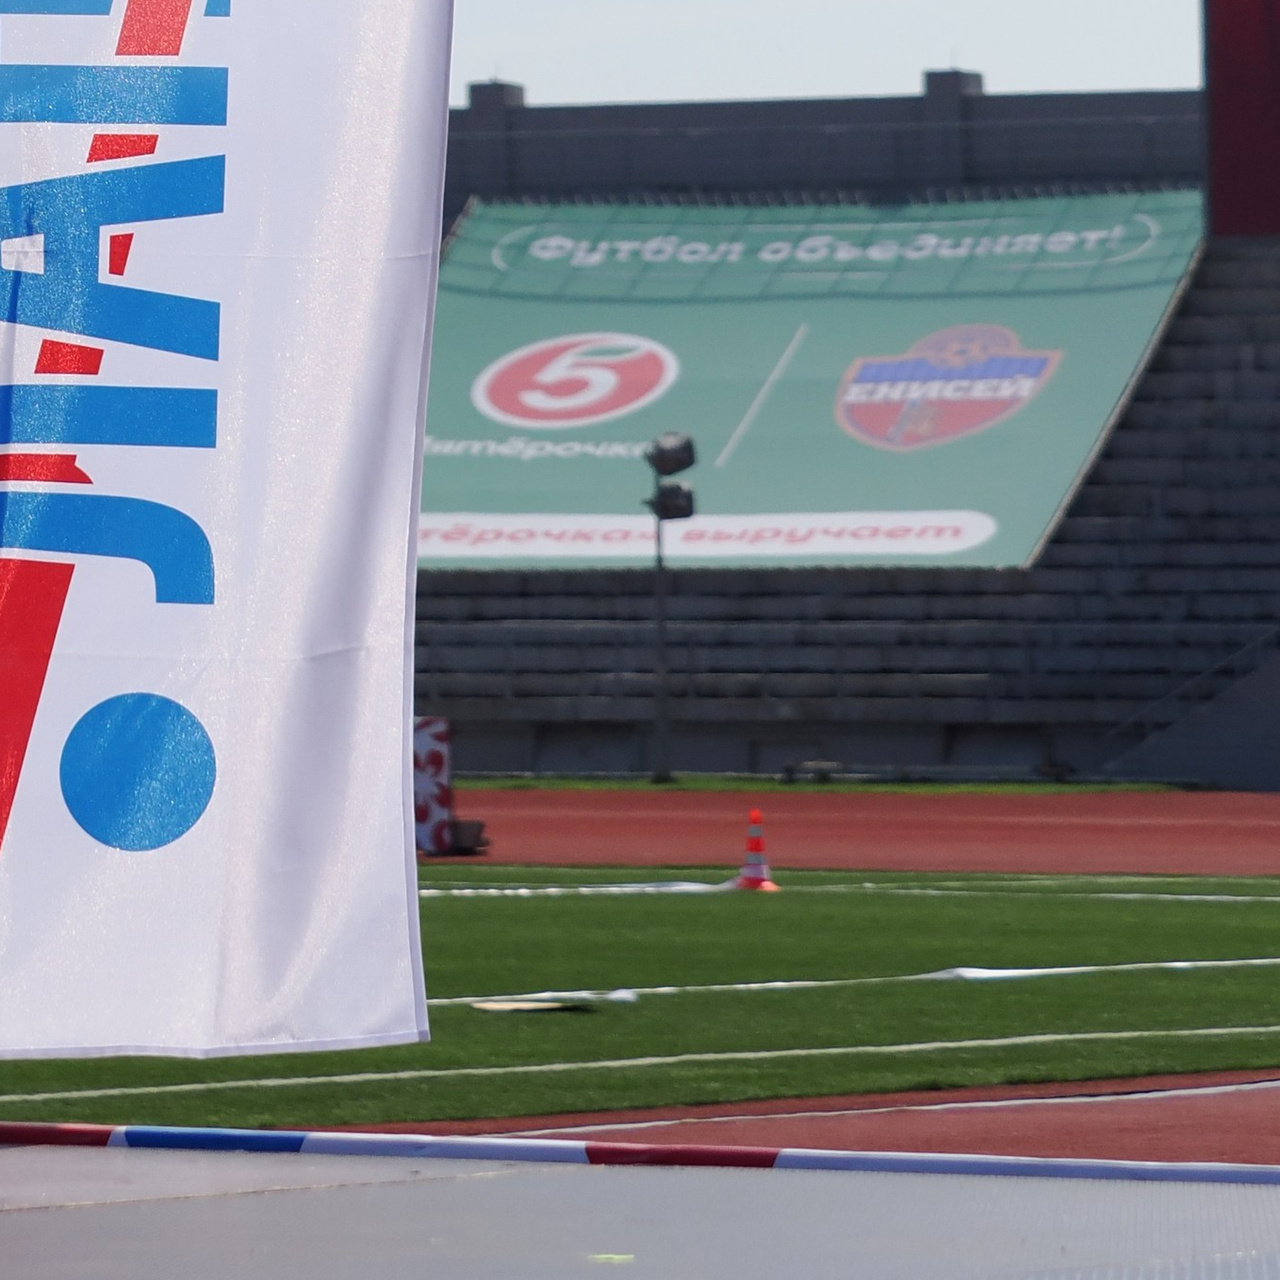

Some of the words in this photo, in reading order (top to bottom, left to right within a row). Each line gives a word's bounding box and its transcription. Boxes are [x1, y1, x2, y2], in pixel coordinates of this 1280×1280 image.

[528, 234, 746, 267] Футбол
[842, 373, 1038, 402] ЕНИСЕЙ
[681, 524, 962, 546] выручает
